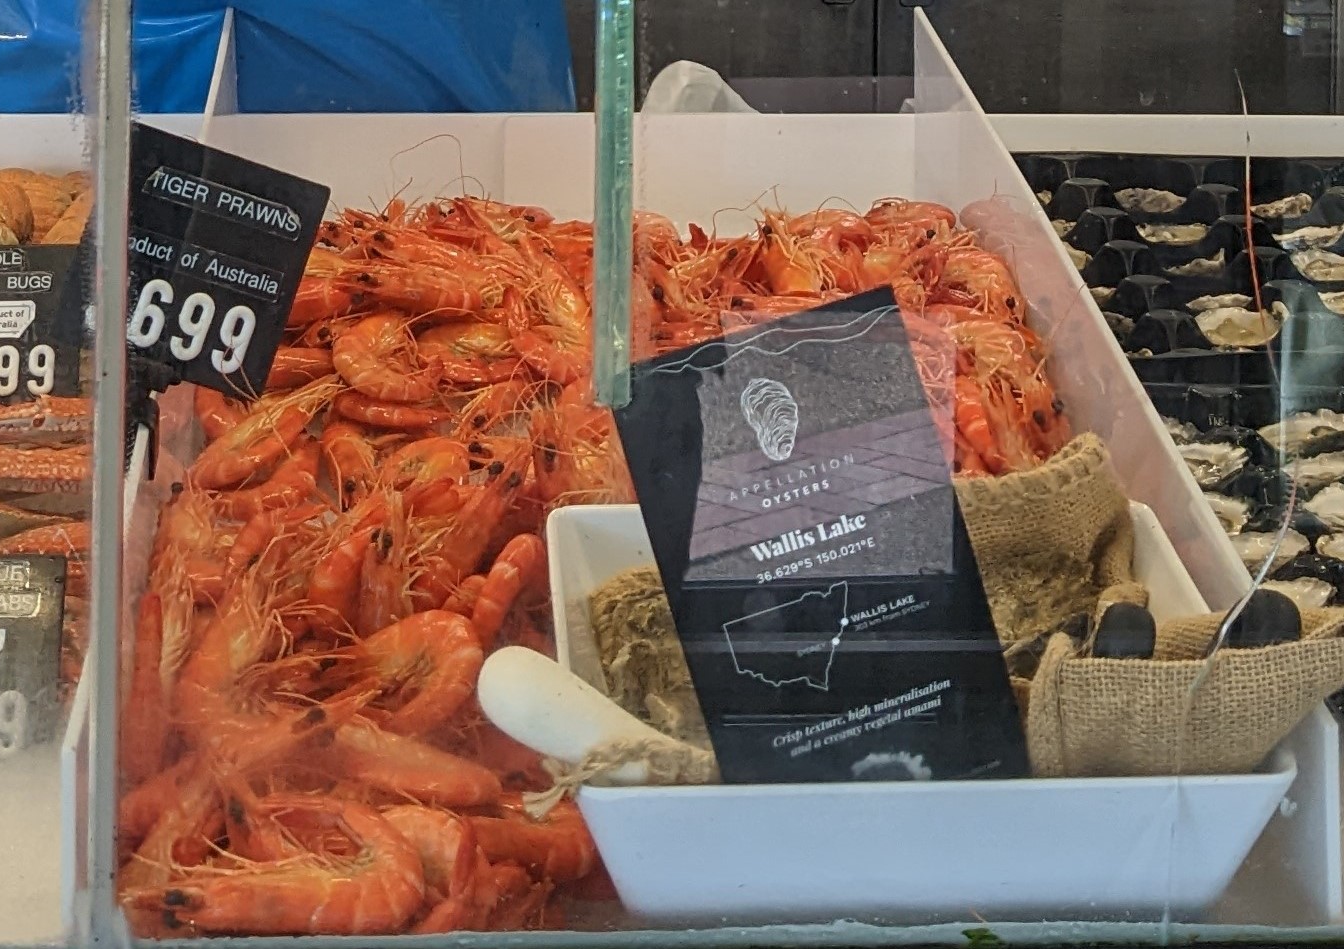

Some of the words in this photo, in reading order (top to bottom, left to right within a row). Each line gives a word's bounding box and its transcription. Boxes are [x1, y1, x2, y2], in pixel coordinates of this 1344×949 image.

[152, 170, 209, 203] TIGER
[216, 192, 298, 232] PRAWNS
[7, 275, 52, 290] BUGS
[180, 252, 200, 269] of
[205, 258, 279, 294] Australia
[16, 310, 25, 318] of
[127, 278, 256, 375] 699
[730, 453, 855, 501] APPELLATION
[762, 479, 830, 508] OYSTERS
[750, 529, 816, 562] Wallis
[815, 513, 867, 541] Lake
[816, 536, 876, 565] 150.021°E
[849, 603, 888, 623] WALLIS
[888, 594, 916, 610] LAKE
[773, 729, 803, 749] Crisp
[848, 704, 871, 722] high
[873, 679, 951, 713] mineralisation
[904, 694, 942, 718] umami
